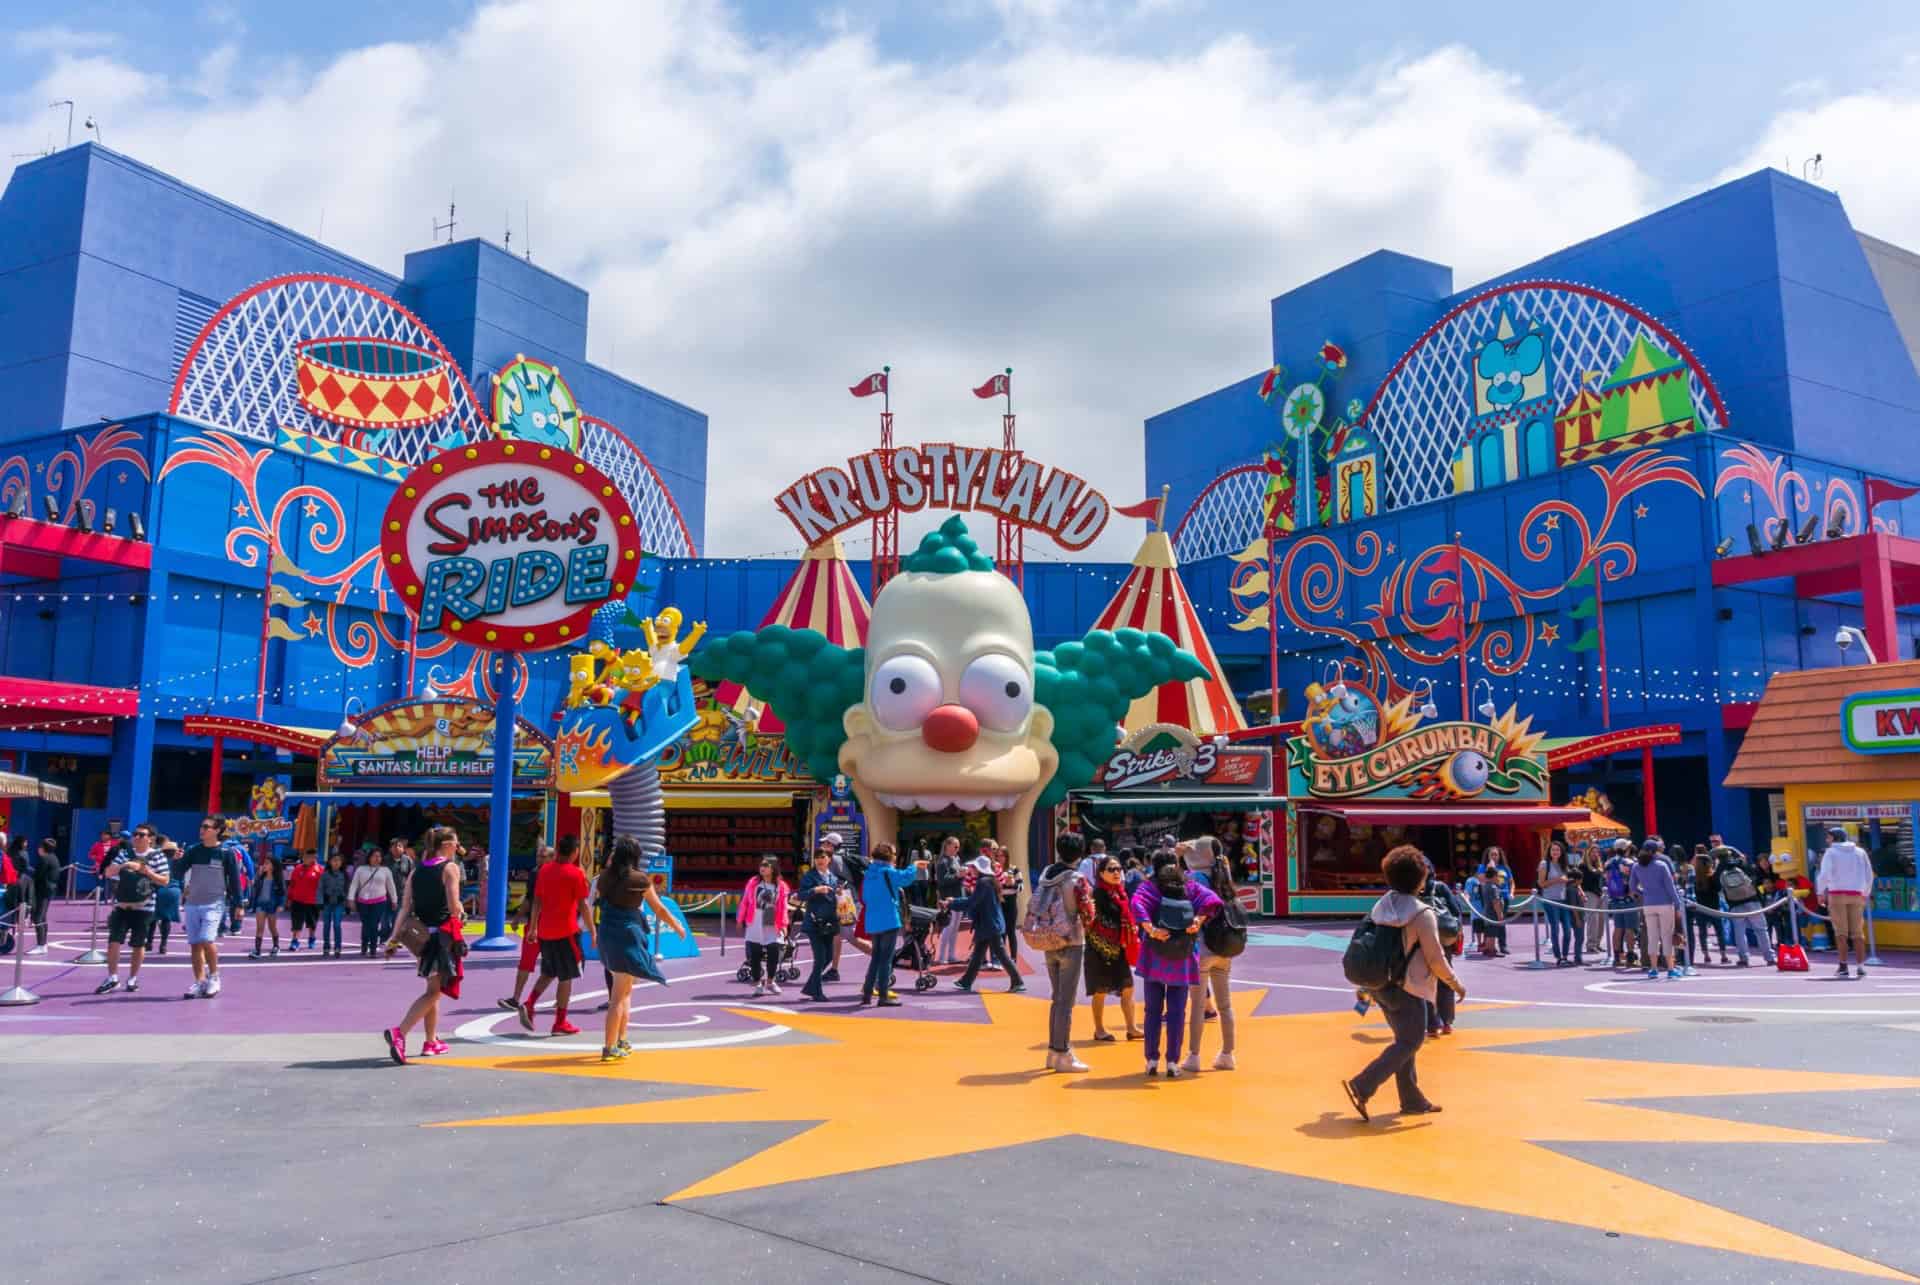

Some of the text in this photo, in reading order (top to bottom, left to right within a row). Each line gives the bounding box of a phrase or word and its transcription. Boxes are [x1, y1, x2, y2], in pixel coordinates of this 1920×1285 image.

[871, 375, 882, 391] K
[994, 377, 1004, 393] K
[776, 443, 1110, 550] KRUSTYLAND
[418, 544, 613, 632] RIDE
[437, 719, 447, 731] 8
[416, 745, 452, 759] HELP
[560, 743, 580, 775] K
[1316, 727, 1498, 791] EYE CARUMBA!
[357, 760, 496, 774] SANTA'S LITTLE HELP
[1104, 751, 1177, 783] Strike
[1193, 744, 1217, 774] 3
[689, 766, 718, 780] AND
